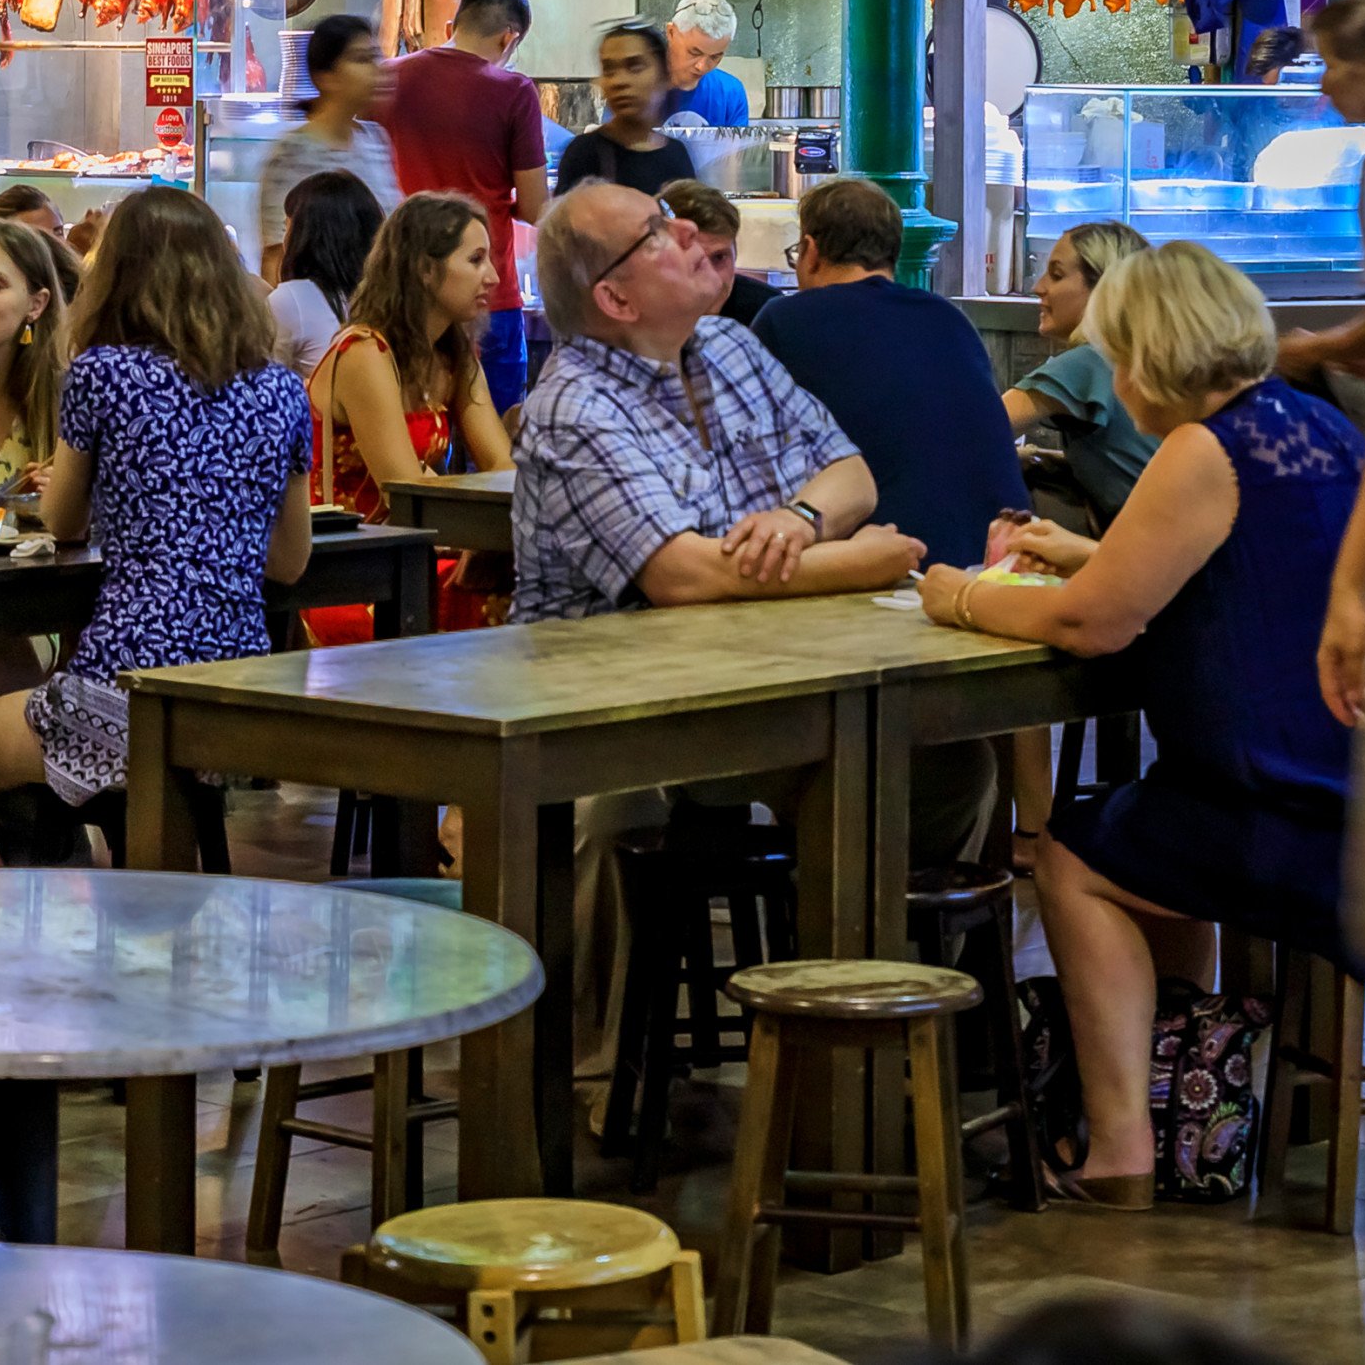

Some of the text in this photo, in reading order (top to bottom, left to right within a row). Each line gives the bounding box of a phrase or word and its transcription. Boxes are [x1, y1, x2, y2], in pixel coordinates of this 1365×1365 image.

[147, 42, 191, 55] SINGAPORE
[148, 56, 190, 66] BEST FOODS
